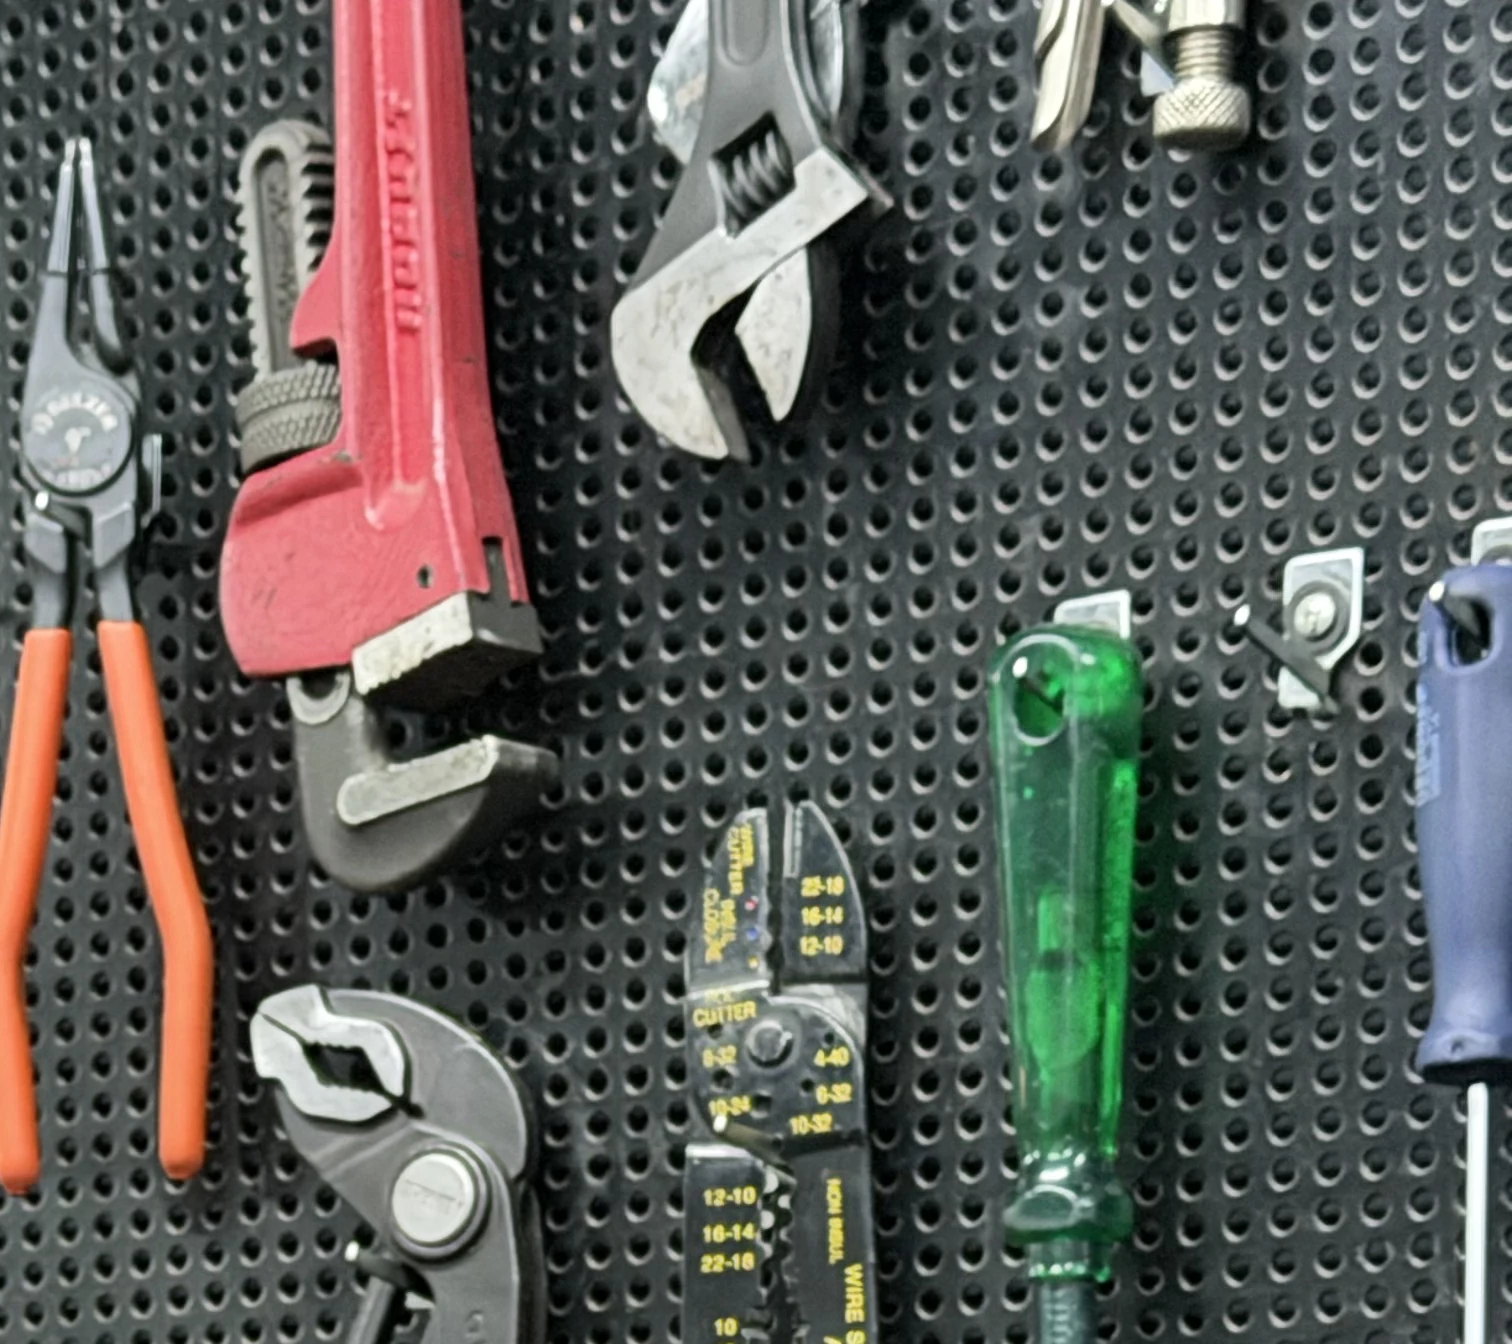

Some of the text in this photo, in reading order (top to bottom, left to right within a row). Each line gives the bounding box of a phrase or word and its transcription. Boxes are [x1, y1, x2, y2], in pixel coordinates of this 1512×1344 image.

[692, 1001, 756, 1027] CUTTER
[813, 1046, 850, 1068] 4-40
[790, 1112, 833, 1135] 10-32
[703, 1185, 757, 1207] 12-10
[702, 1222, 755, 1244] 16-14
[844, 1263, 865, 1323] WIRE
[714, 1316, 738, 1337] 10
